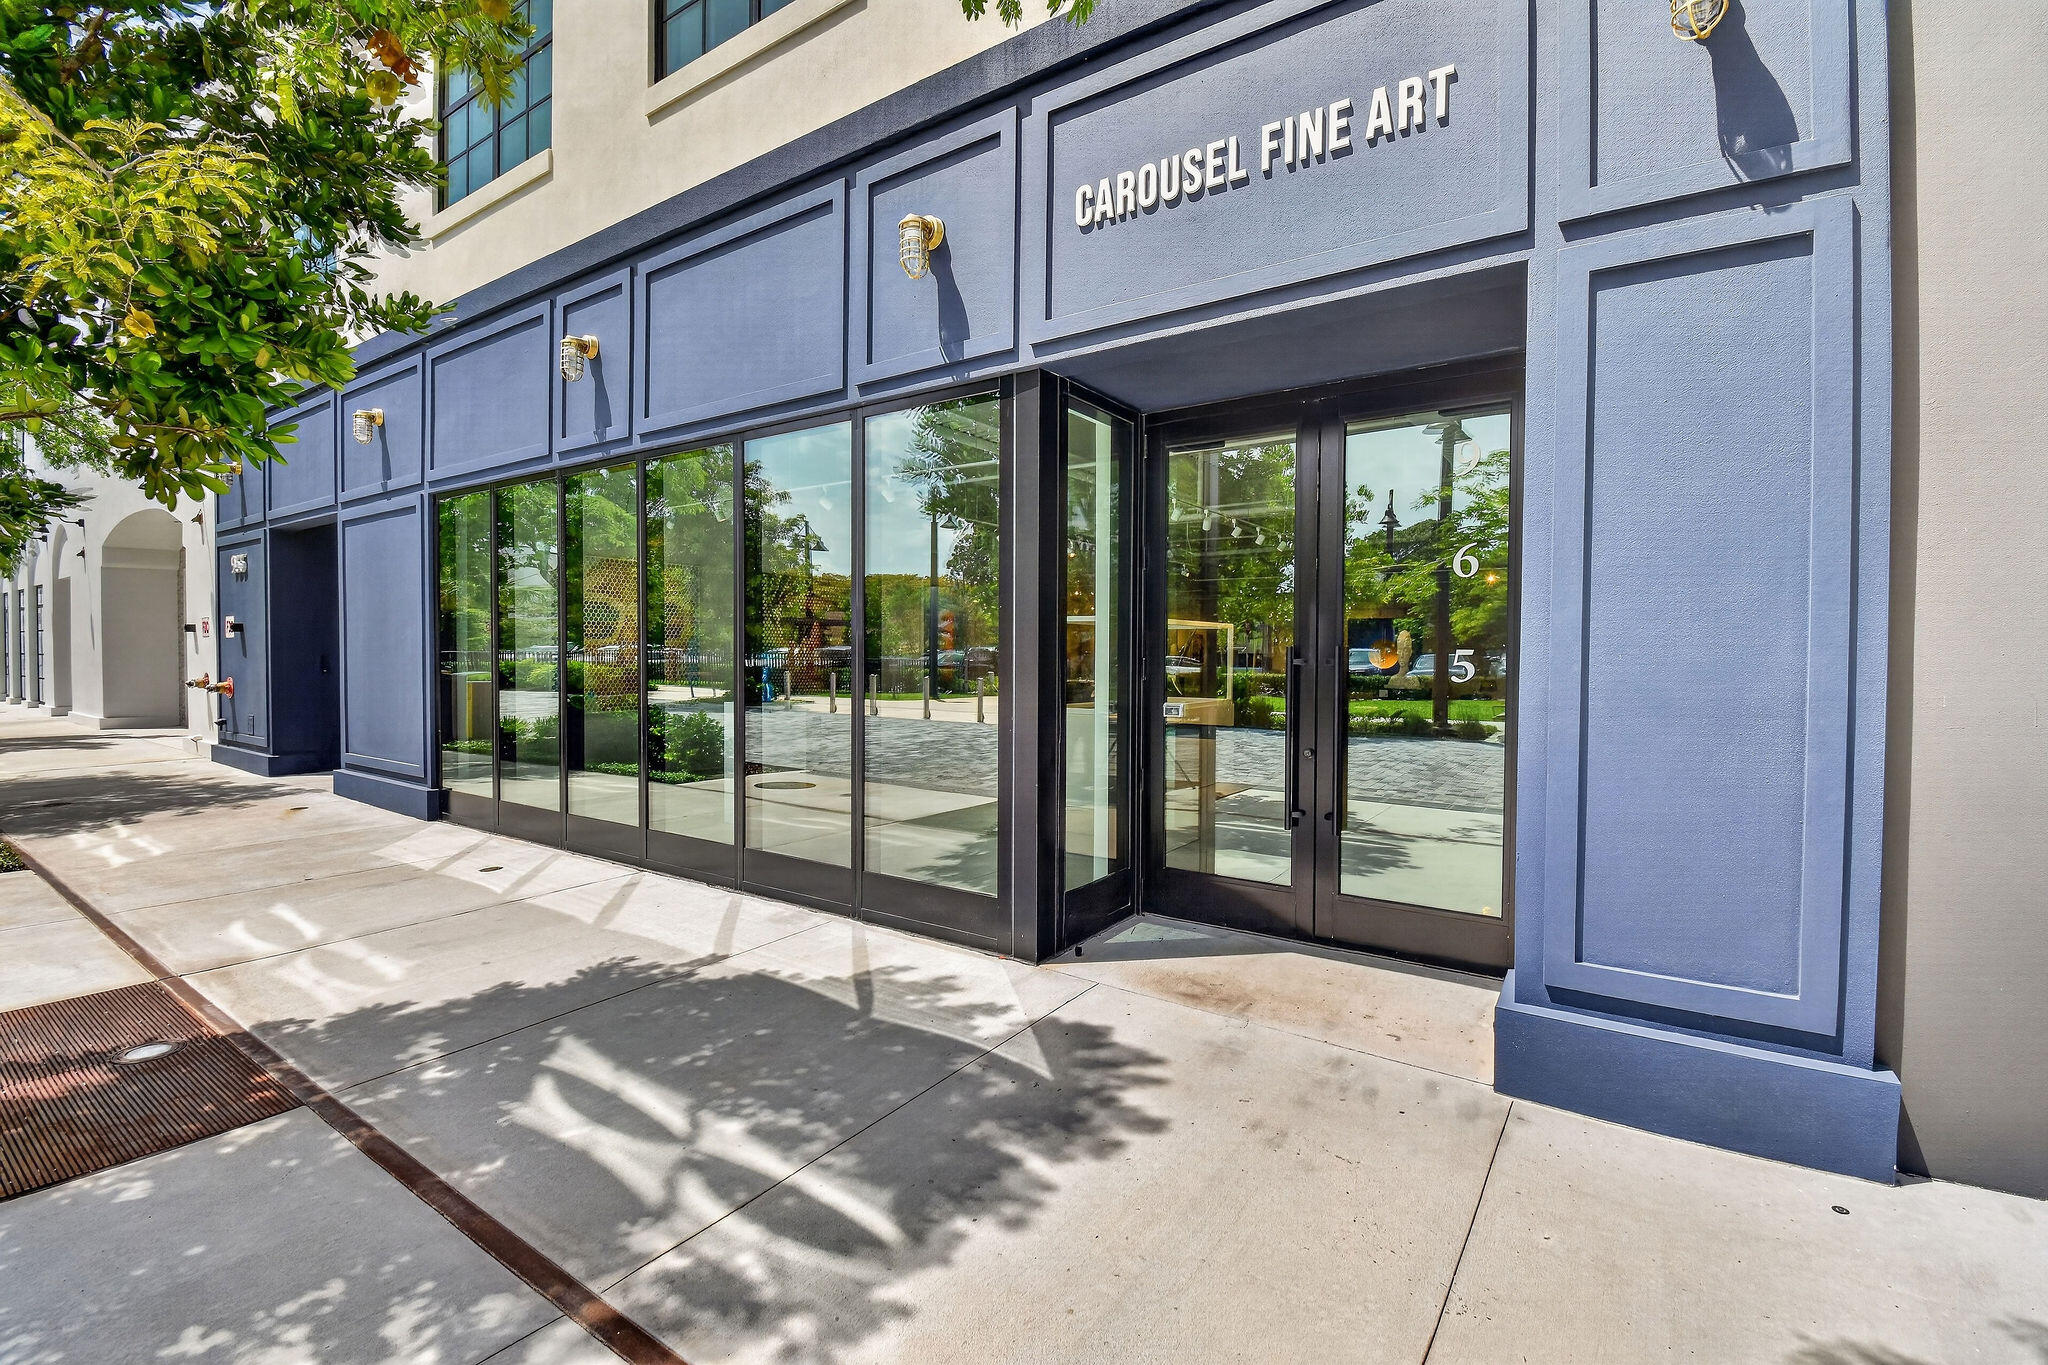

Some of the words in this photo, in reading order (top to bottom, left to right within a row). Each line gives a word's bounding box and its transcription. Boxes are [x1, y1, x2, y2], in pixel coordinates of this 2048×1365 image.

[1075, 135, 1248, 228] CAROUSEL
[1260, 97, 1353, 174] FINE
[1365, 63, 1456, 141] ART
